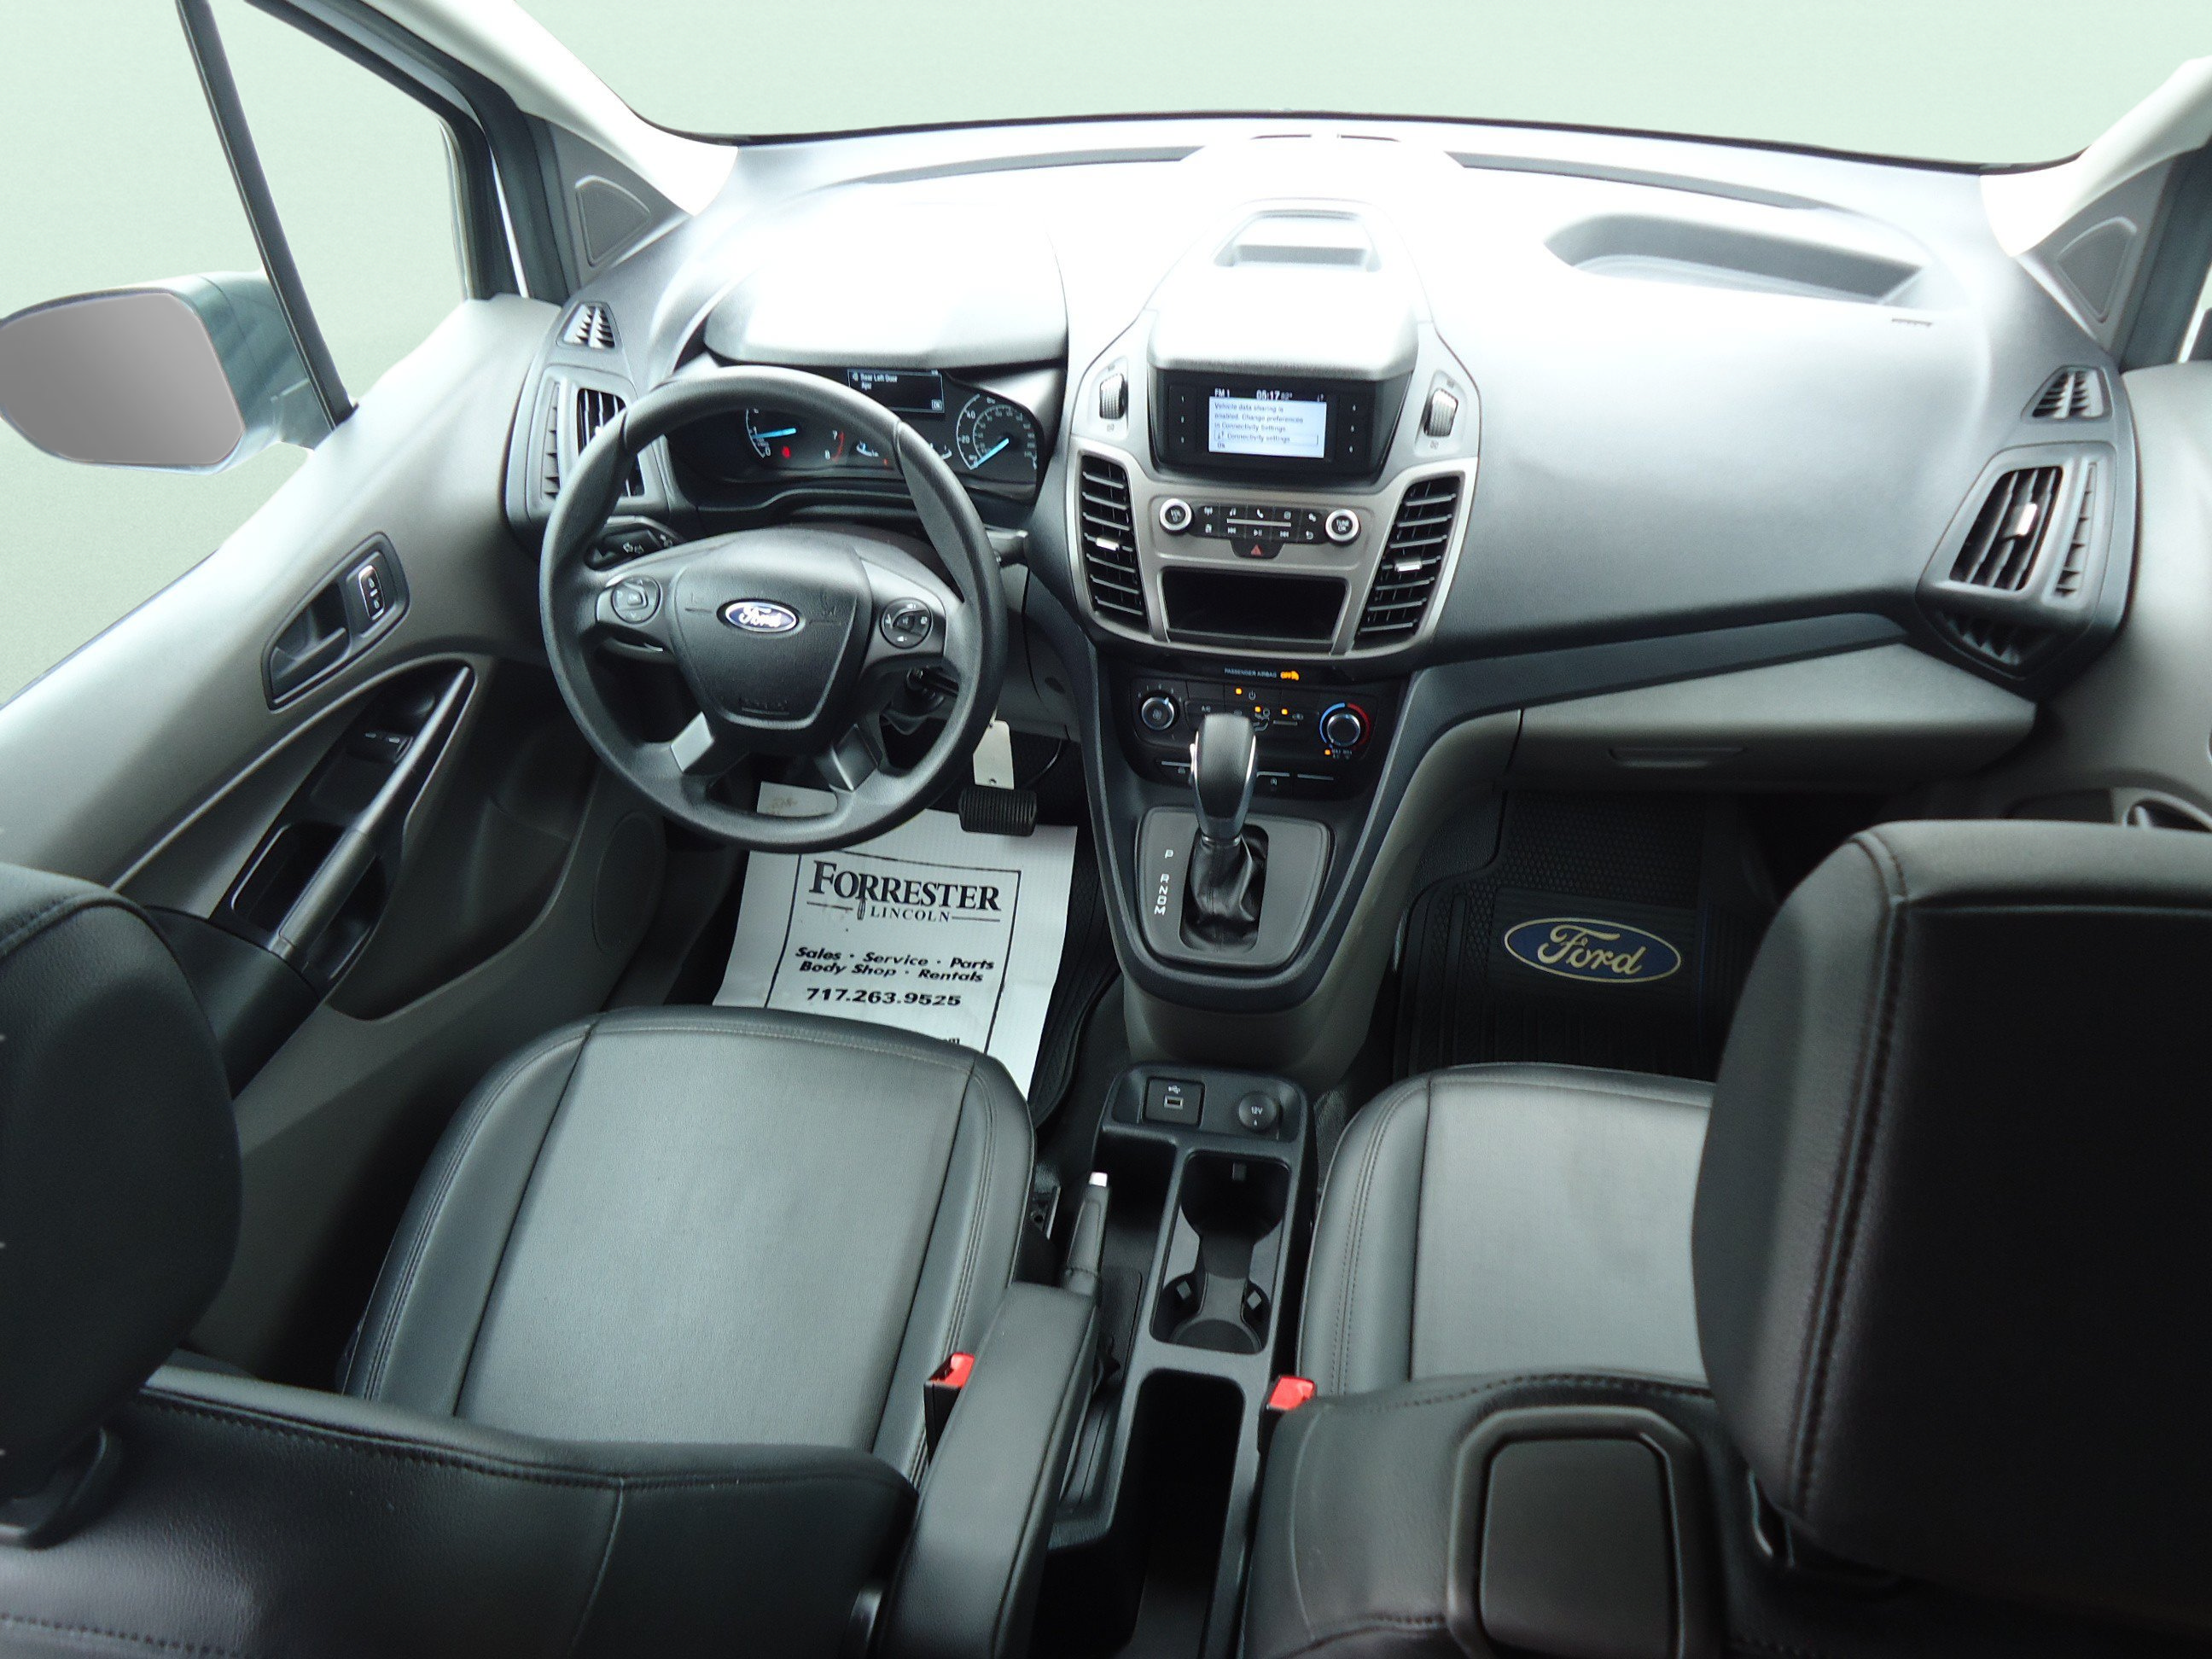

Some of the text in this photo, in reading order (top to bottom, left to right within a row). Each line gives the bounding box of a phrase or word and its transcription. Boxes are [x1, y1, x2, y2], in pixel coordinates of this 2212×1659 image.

[874, 373, 885, 382] Left
[1214, 387, 1225, 398] FM
[1242, 414, 1266, 422] Change
[1221, 422, 1260, 432] Connectivity
[1227, 433, 1264, 442] Connectivity
[1165, 849, 1173, 859] P
[1160, 873, 1170, 883] R
[808, 859, 1002, 911] FORRESTER
[1158, 884, 1168, 895] N
[870, 905, 951, 923] LINCOLN
[1154, 905, 1167, 916] M
[1537, 923, 1647, 975] Ford
[795, 946, 995, 970] Sales Service Parts
[799, 960, 984, 982] Body Shop Rentals
[806, 987, 962, 1007] 717.263.9525
[1251, 1106, 1263, 1115] 12V
